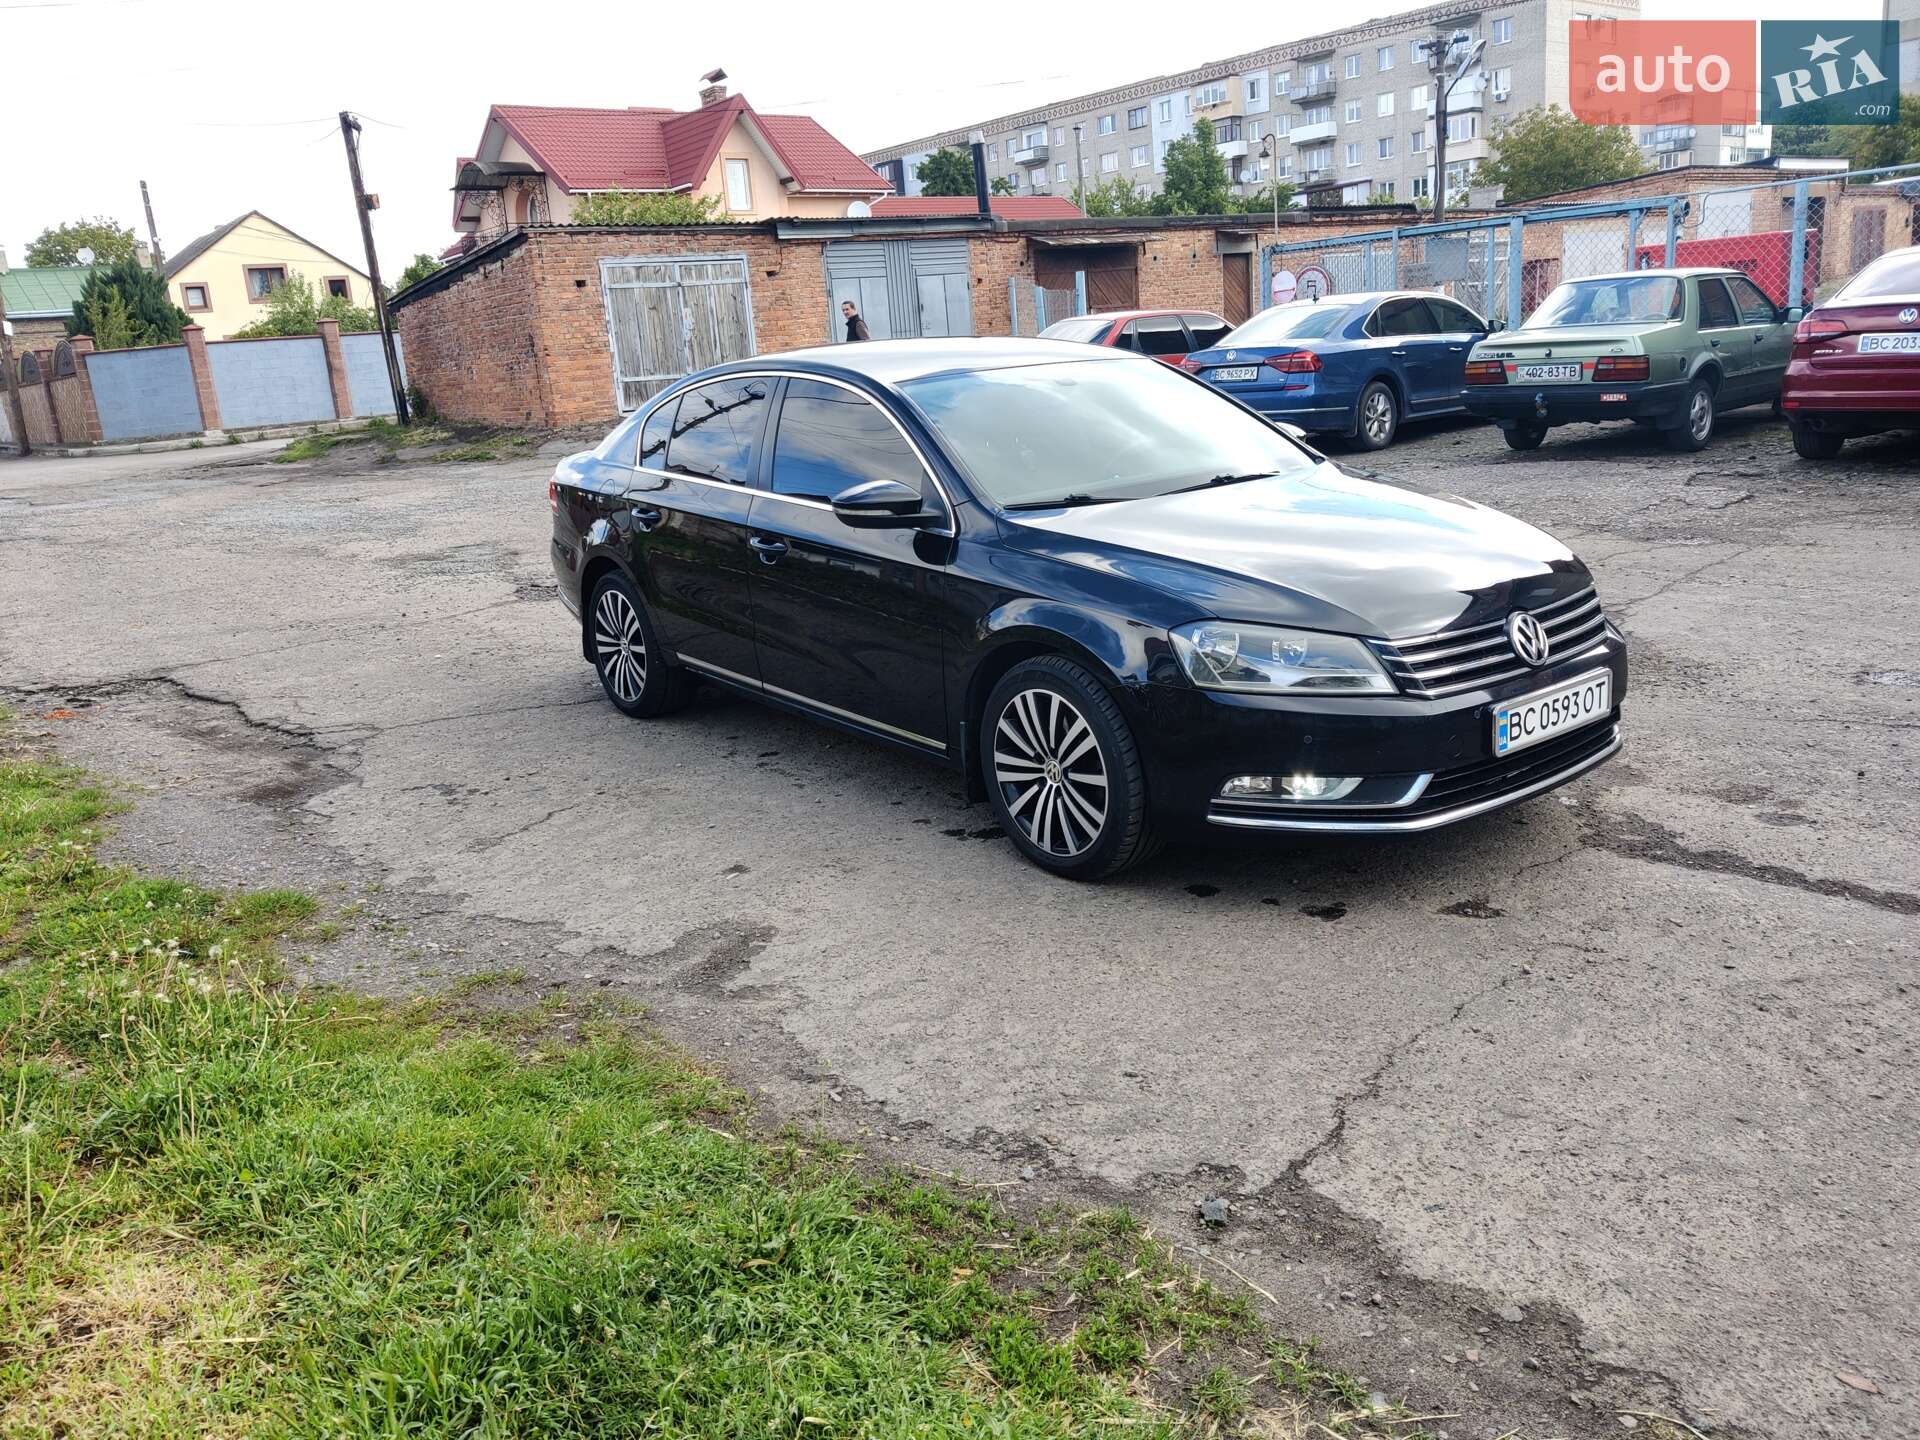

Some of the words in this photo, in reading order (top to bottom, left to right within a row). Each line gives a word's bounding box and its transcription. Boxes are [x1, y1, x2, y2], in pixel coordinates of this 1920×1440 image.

[1892, 336, 1920, 349] 203
[1509, 707, 1536, 741] BC
[1540, 691, 1580, 729] 0593
[1583, 681, 1606, 713] OT
